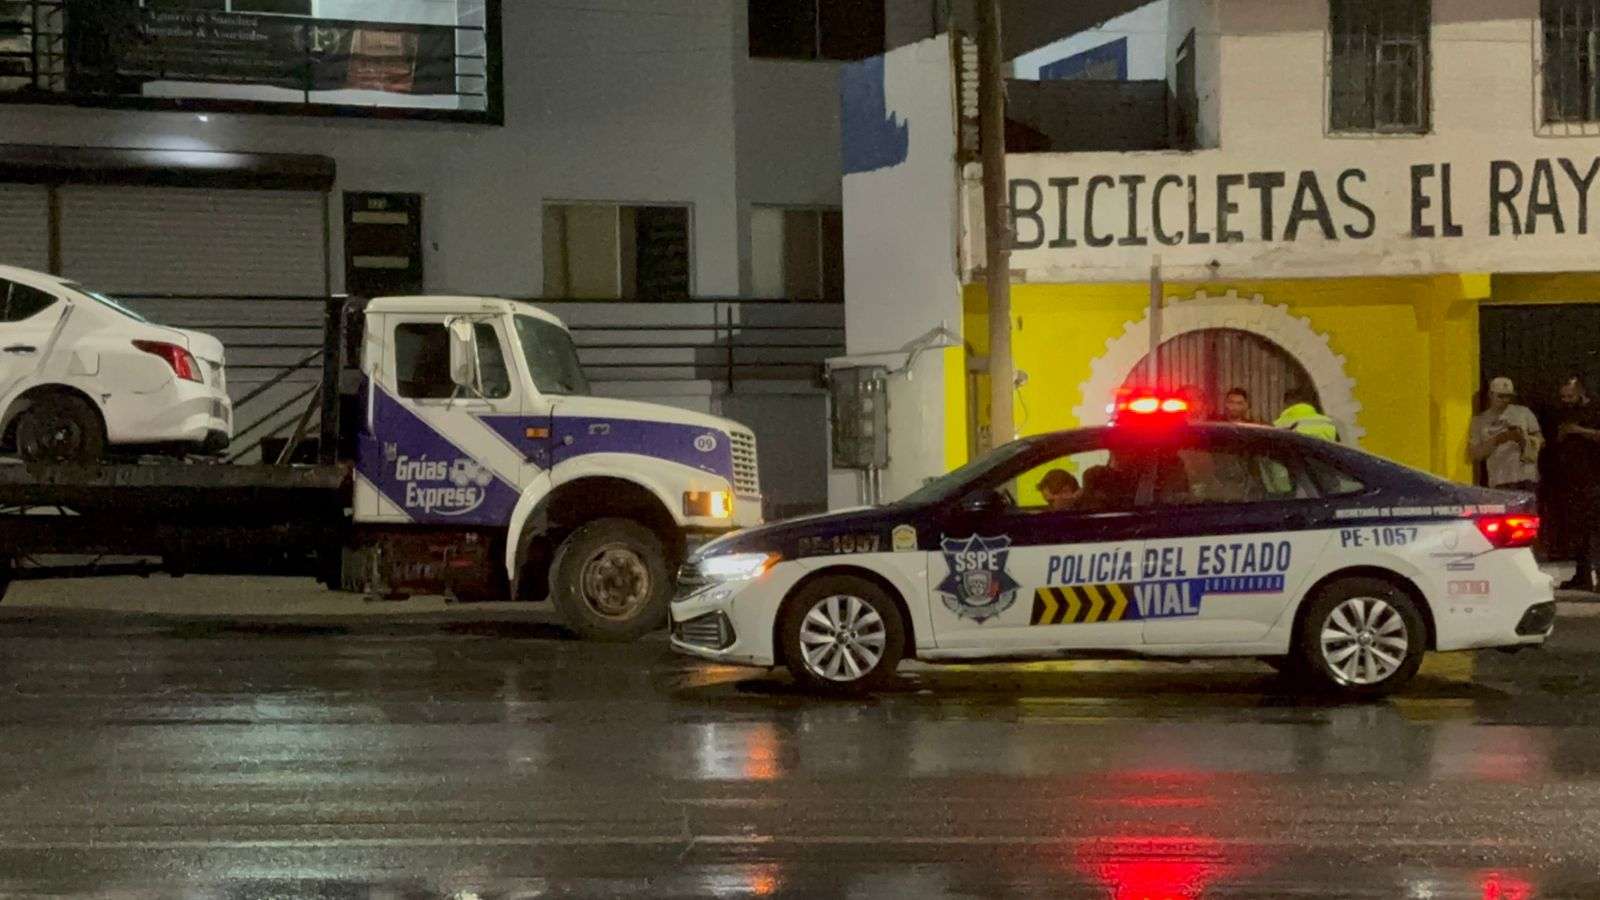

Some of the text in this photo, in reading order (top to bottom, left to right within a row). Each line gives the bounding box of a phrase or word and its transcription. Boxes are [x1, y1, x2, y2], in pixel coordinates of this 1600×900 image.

[1008, 157, 1600, 250] BICICLETAS EL RAY
[698, 438, 713, 449] 09
[395, 453, 448, 481] Grúas
[405, 481, 477, 514] Express
[1340, 527, 1418, 548] PE-1057
[954, 550, 1000, 572] SSPE
[1046, 540, 1292, 585] POLICÍA DEL ESTADO
[1133, 582, 1199, 617] VIAL
